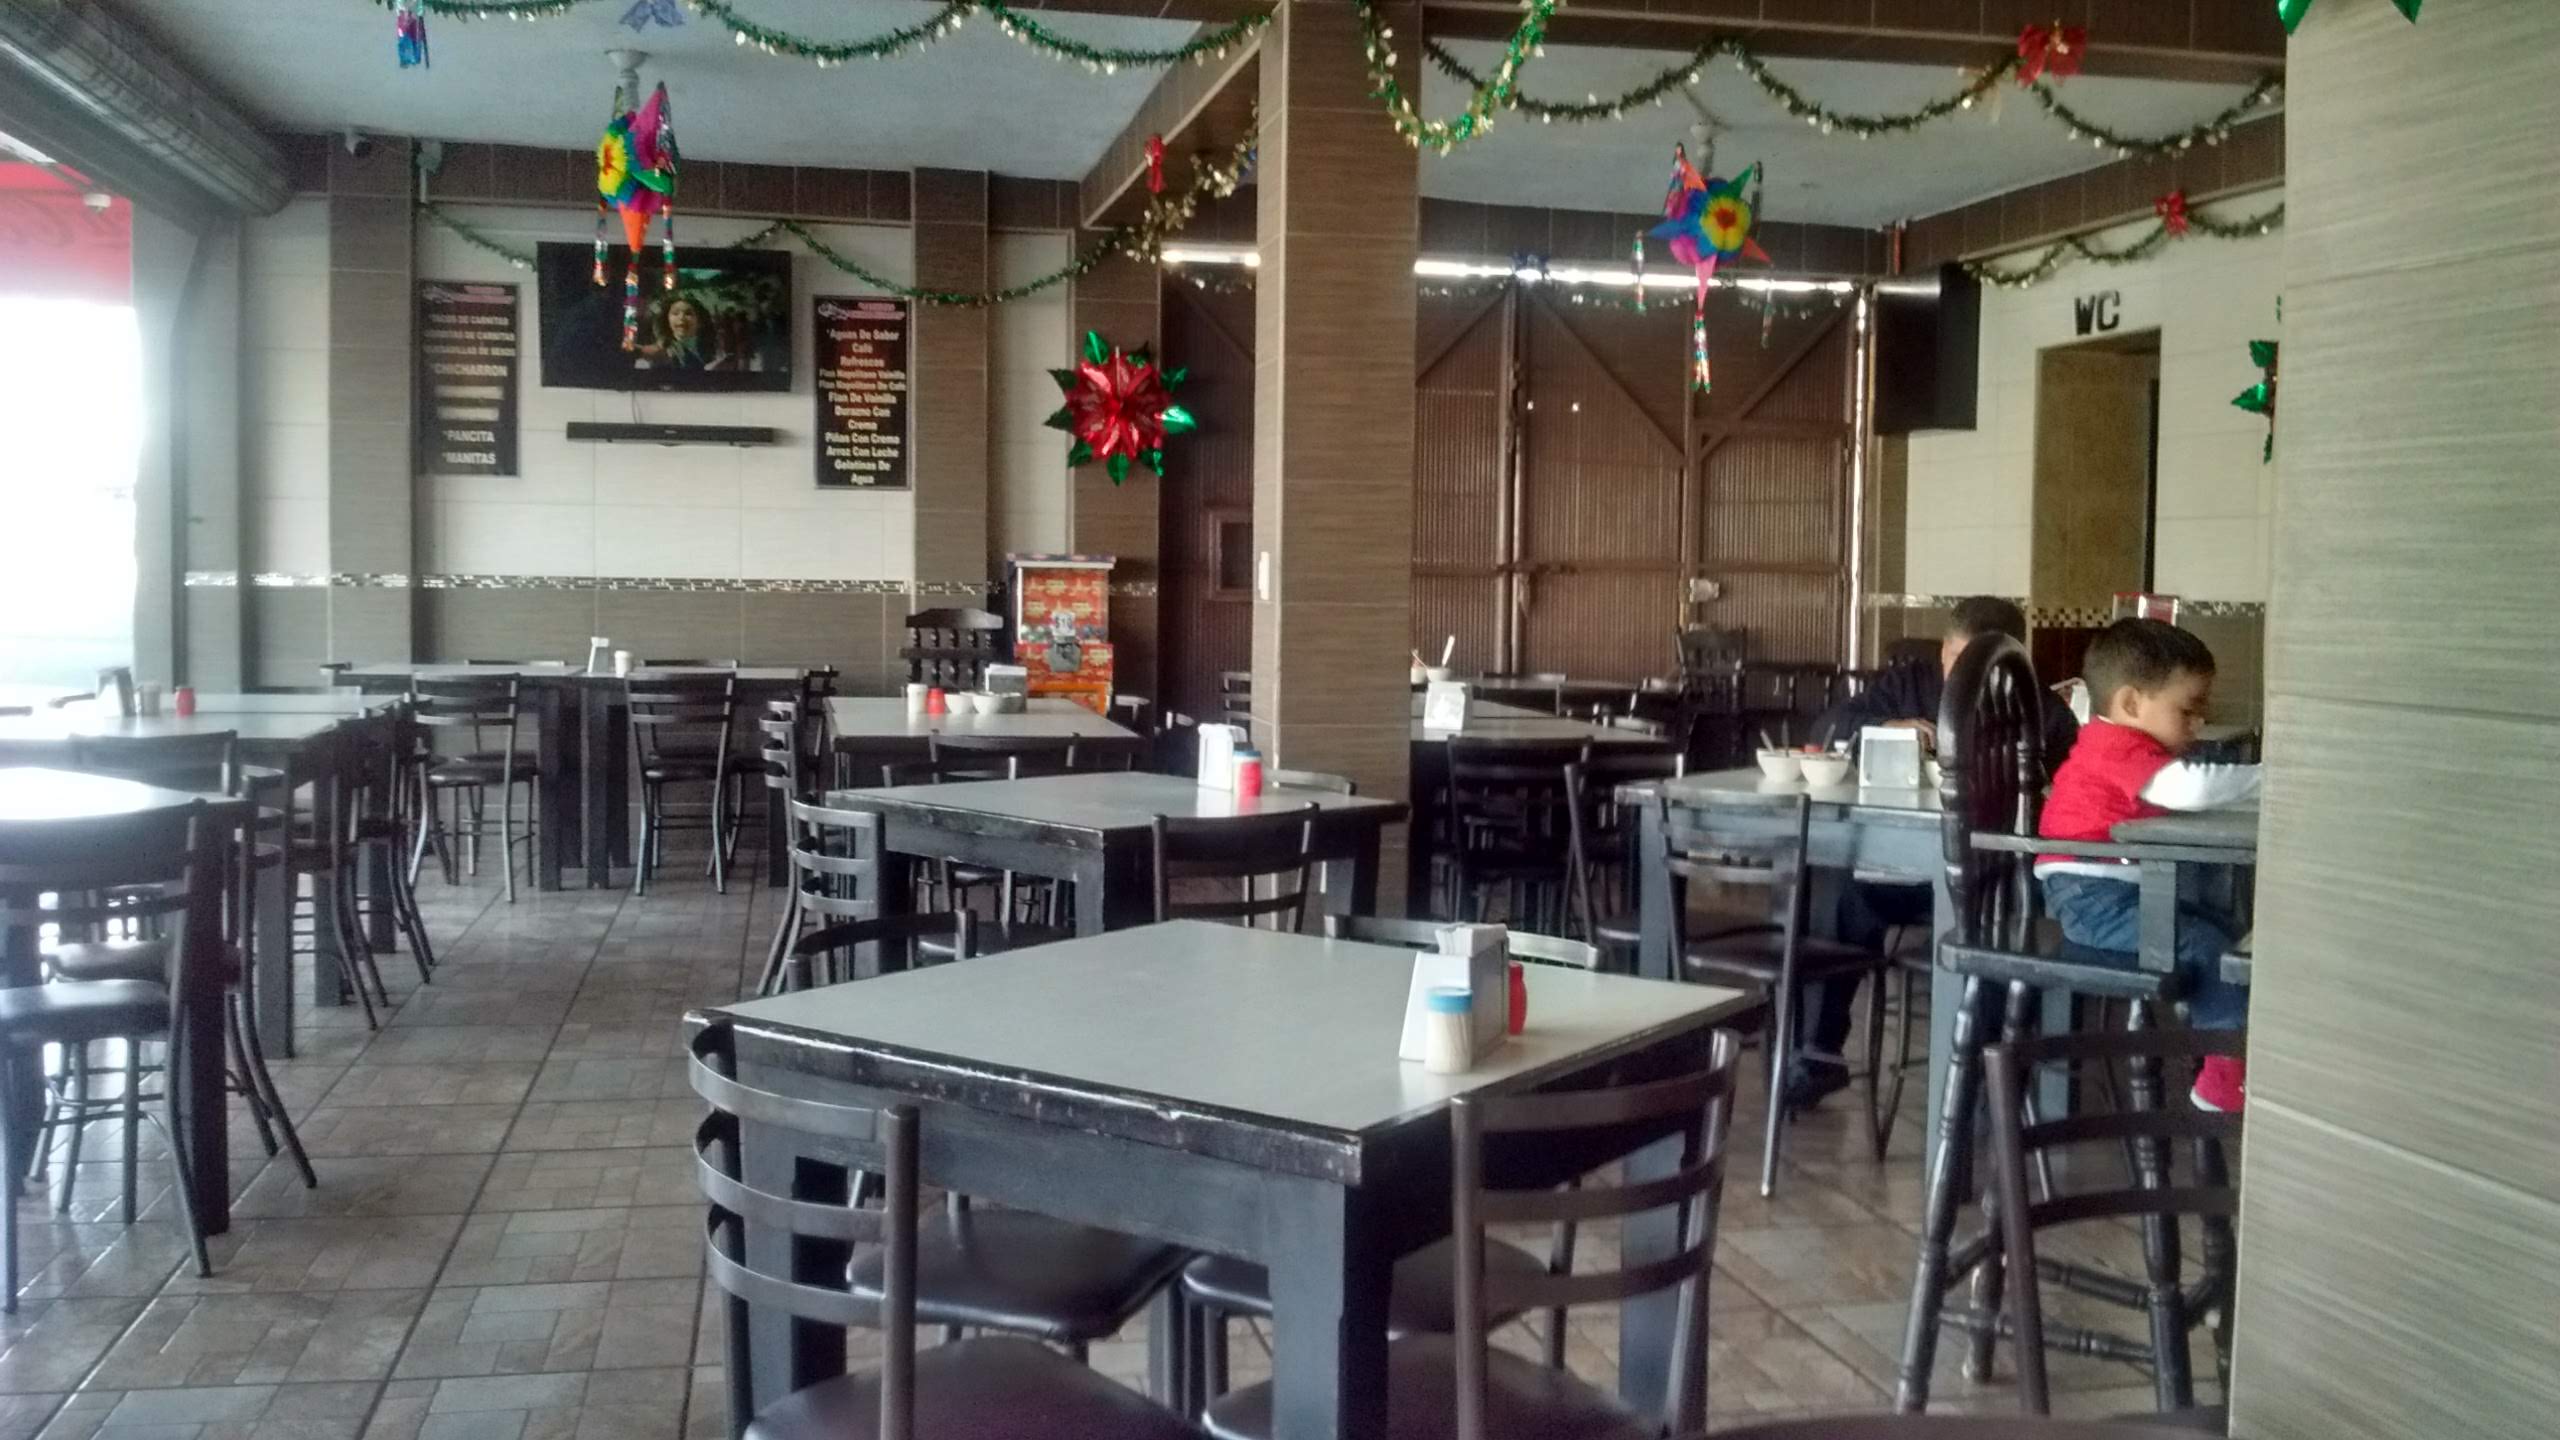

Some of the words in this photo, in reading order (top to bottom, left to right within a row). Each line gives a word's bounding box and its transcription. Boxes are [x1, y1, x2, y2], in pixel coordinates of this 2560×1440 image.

[2074, 290, 2120, 336] WC
[476, 331, 515, 342] CARNITAS
[859, 329, 872, 340] De
[872, 329, 900, 341] Sabor
[840, 356, 885, 368] Refrescos
[434, 363, 508, 378] CHICHARRON
[828, 391, 849, 403] Flan
[849, 392, 863, 403] De
[863, 392, 897, 404] Vainilla
[834, 405, 872, 417] Durazno
[872, 406, 891, 418] Con
[848, 419, 878, 431] Crema
[446, 430, 496, 443] PANCITA
[851, 432, 870, 444] Con
[870, 433, 901, 445] Crema
[445, 451, 497, 465] MANITAS
[826, 445, 851, 457] Arroz
[852, 446, 870, 457] Con
[871, 447, 899, 458] Leche
[834, 458, 878, 471] Gelatinas
[877, 460, 891, 471] De
[850, 472, 875, 486] Agua
